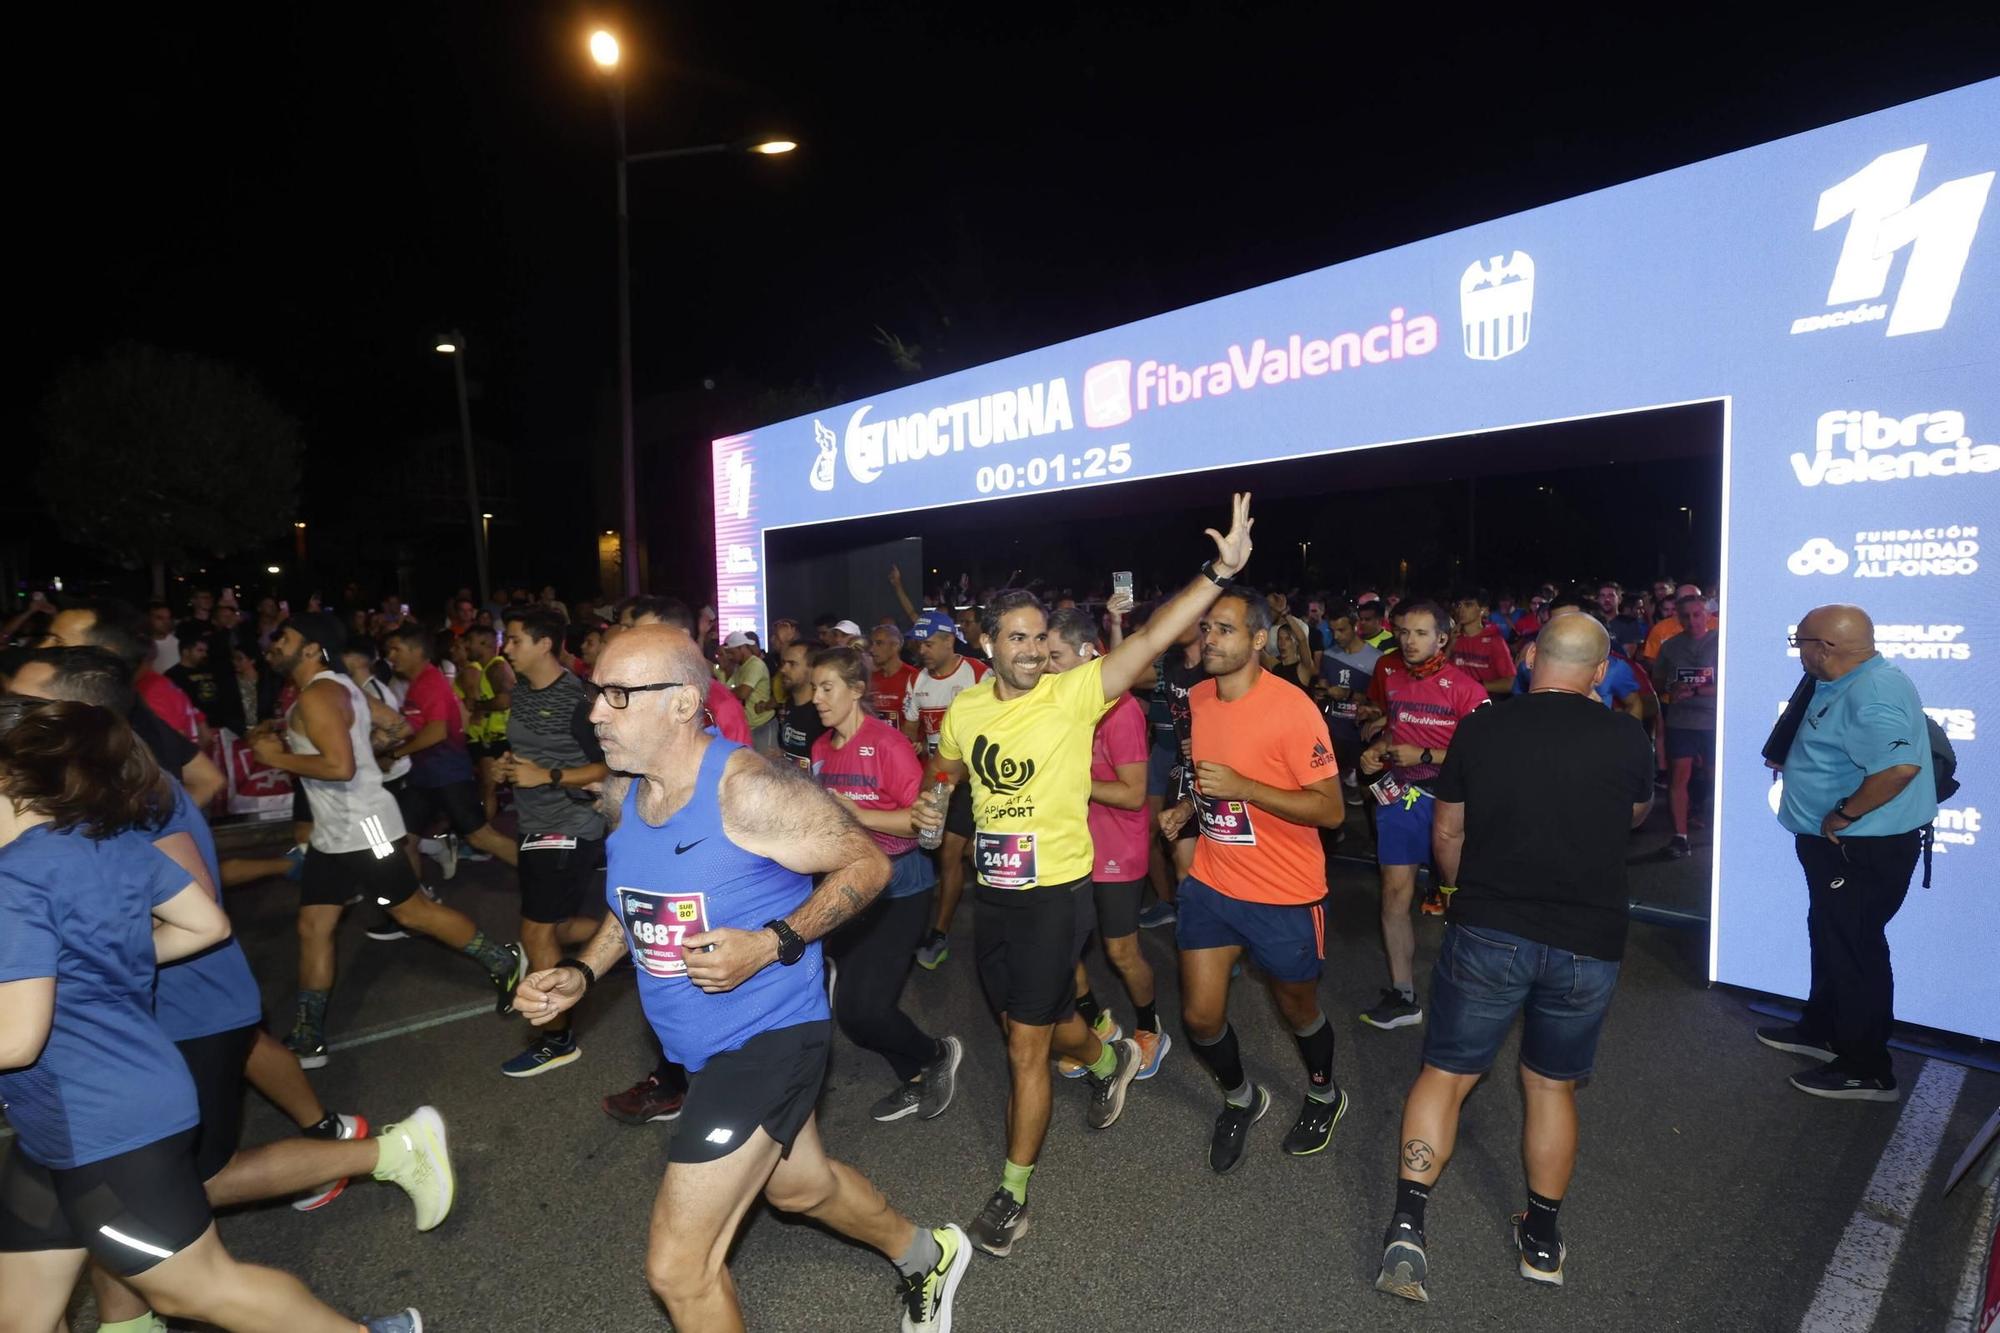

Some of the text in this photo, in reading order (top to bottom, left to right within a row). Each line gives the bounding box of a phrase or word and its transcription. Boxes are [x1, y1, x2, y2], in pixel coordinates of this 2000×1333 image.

[887, 377, 1074, 464] NOCTURNA
[975, 443, 1132, 493] 00:01:25
[1791, 437, 2000, 486] Valencia
[1855, 525, 1978, 543] FUNDACIÓN
[1854, 540, 1980, 561] TRINIDAD
[1854, 558, 1979, 578] ALFONSO
[983, 851, 1022, 868] 2414
[633, 920, 686, 946] 4887
